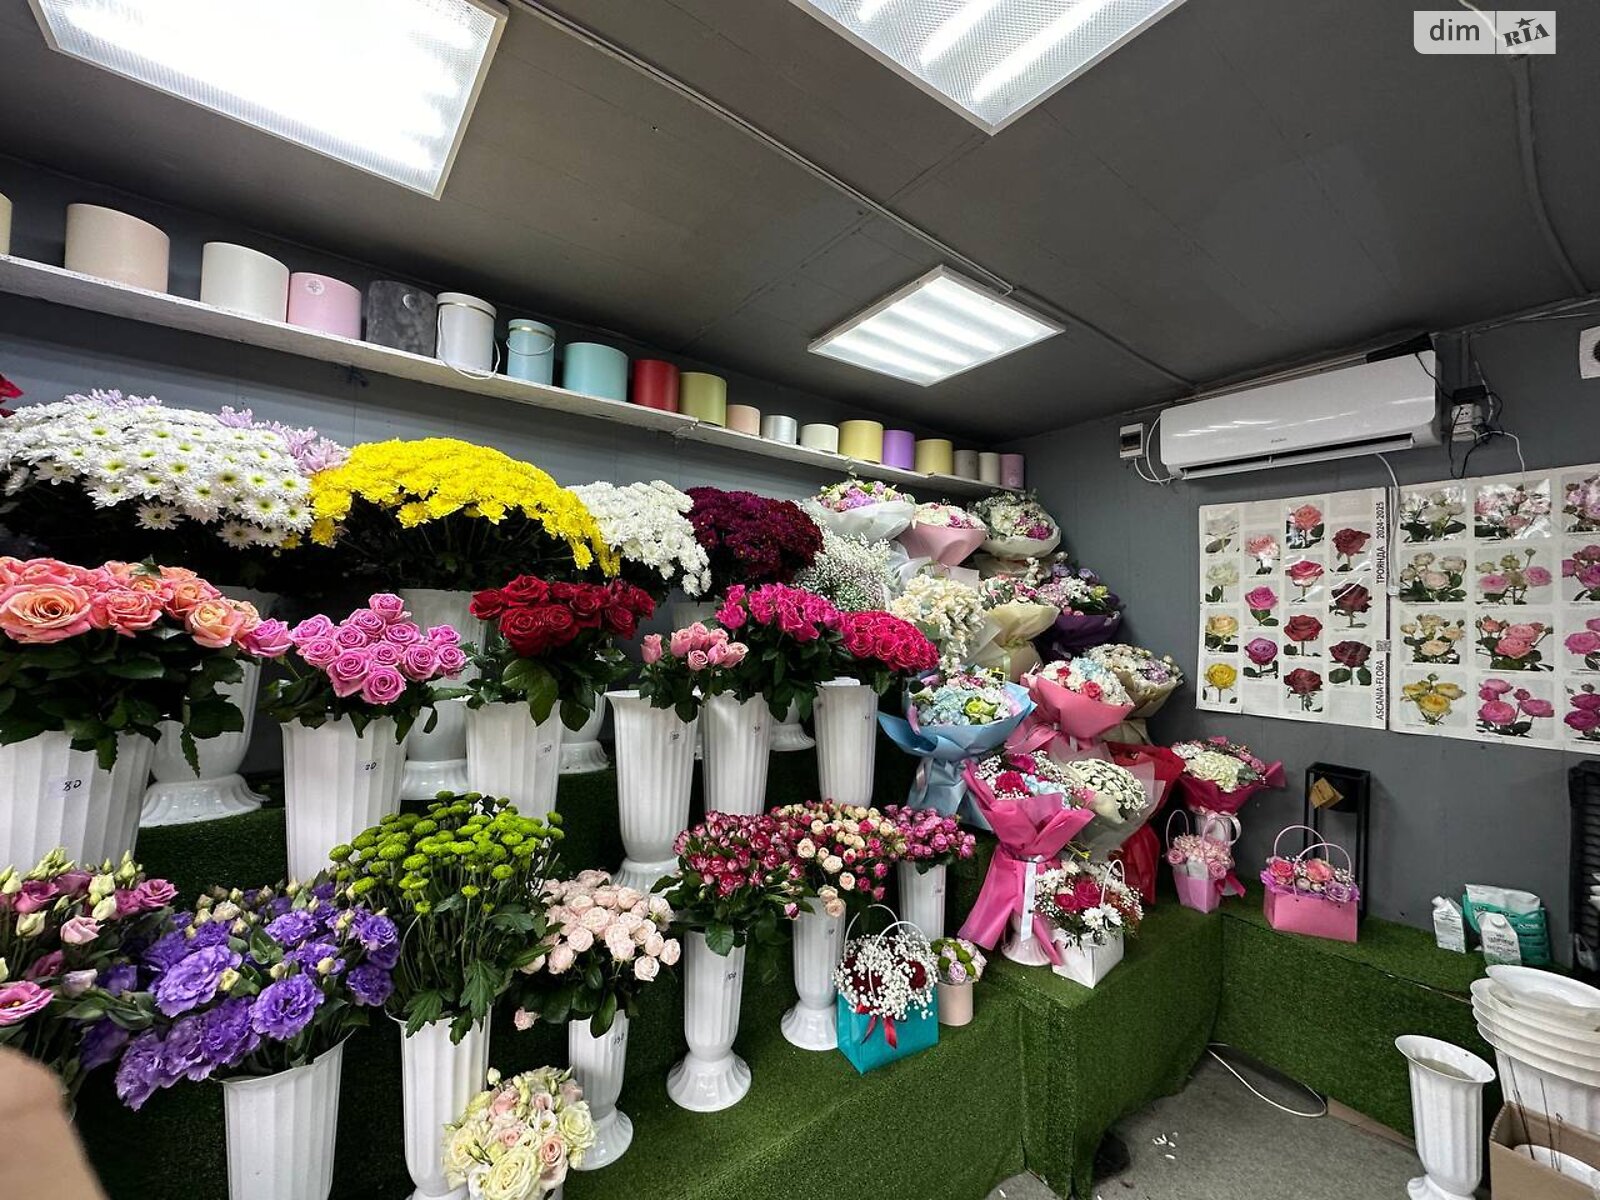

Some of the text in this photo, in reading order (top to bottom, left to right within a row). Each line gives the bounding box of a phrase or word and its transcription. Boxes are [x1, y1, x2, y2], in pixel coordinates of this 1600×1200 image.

[1376, 501, 1385, 584] ТРОЯНДА 2024-2025
[63, 779, 82, 791] 80
